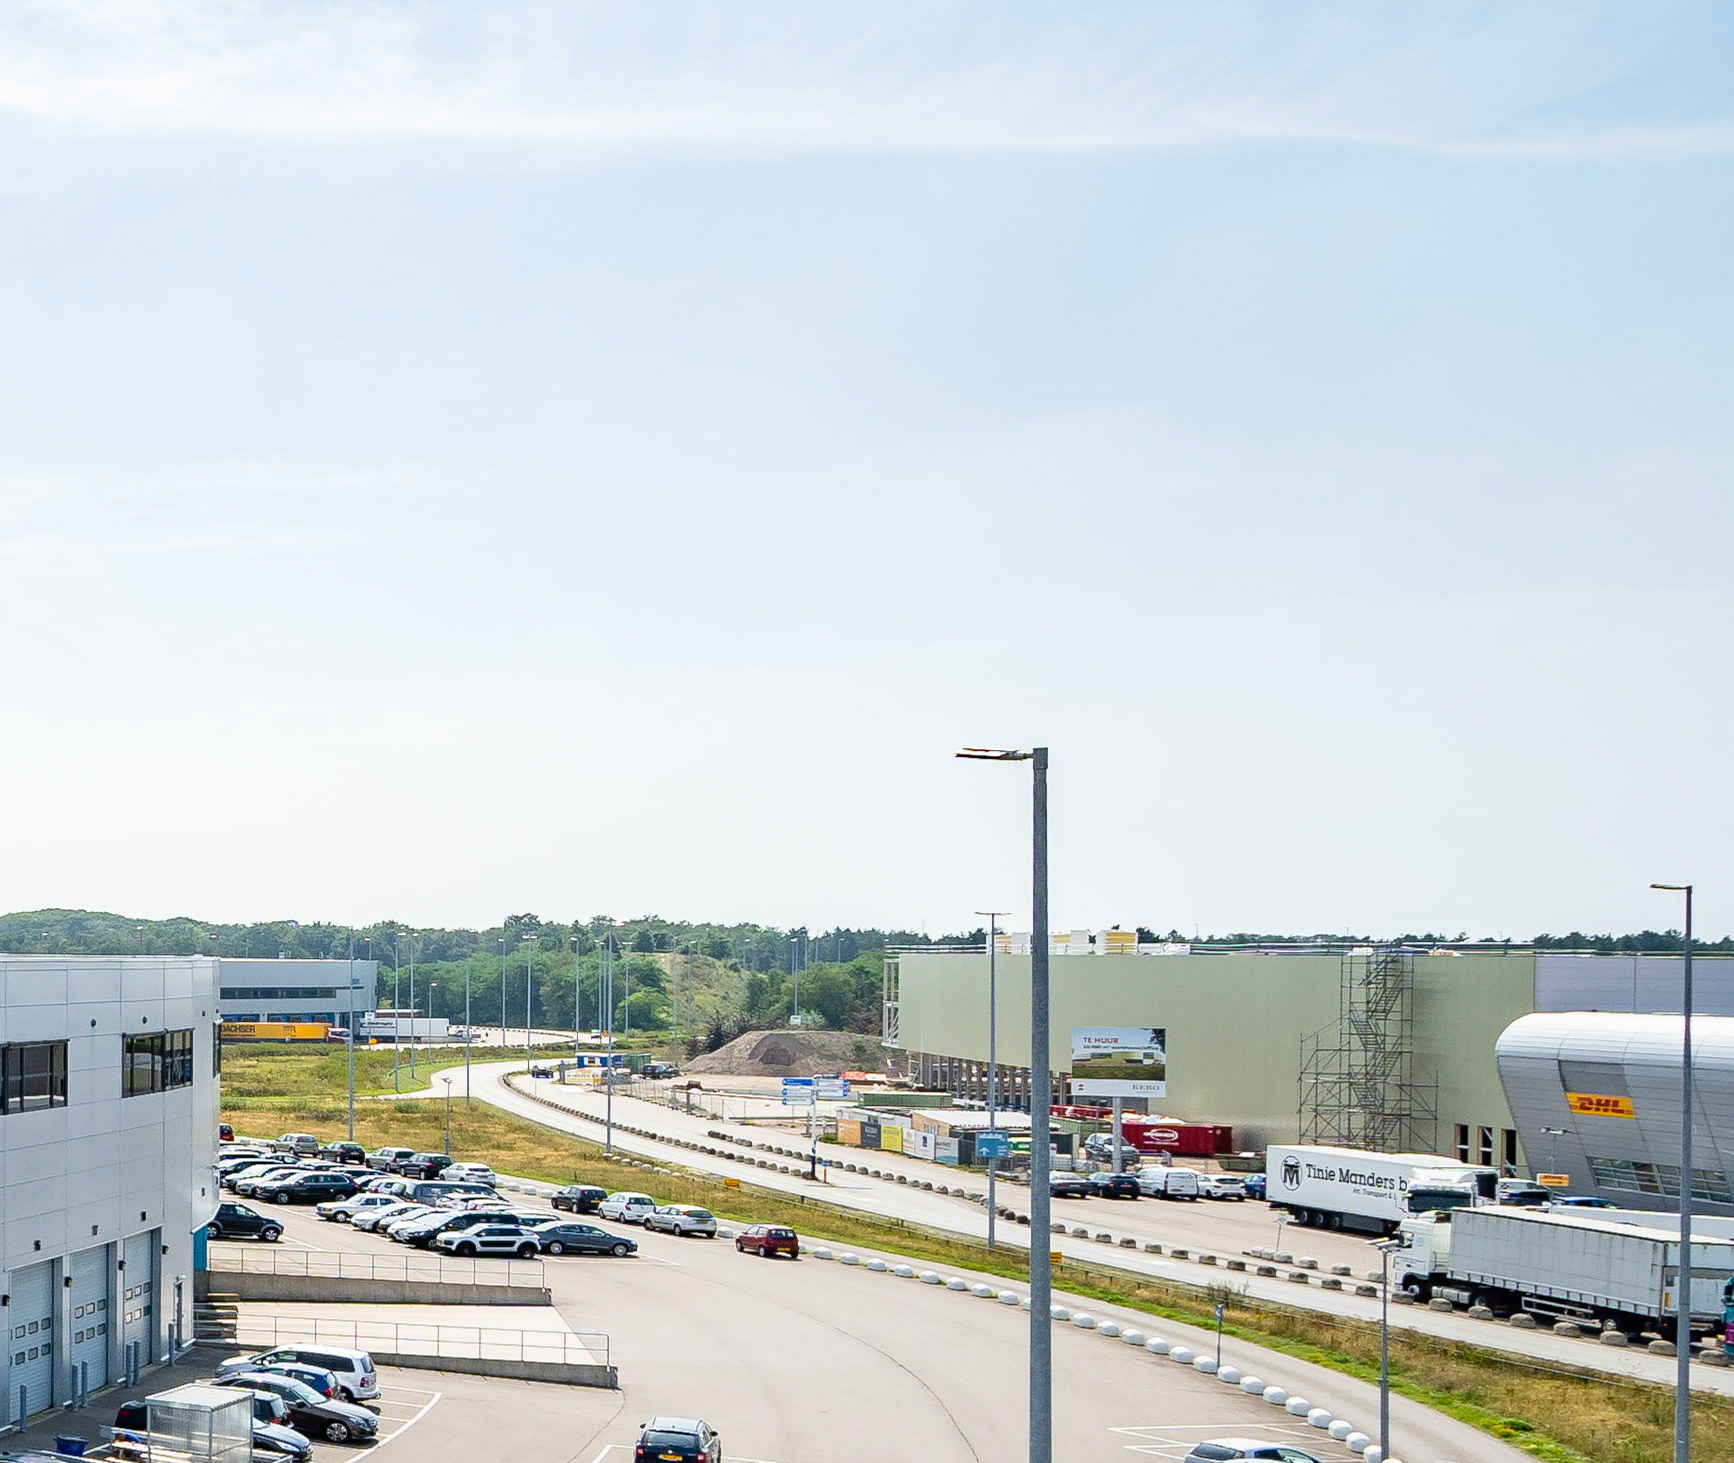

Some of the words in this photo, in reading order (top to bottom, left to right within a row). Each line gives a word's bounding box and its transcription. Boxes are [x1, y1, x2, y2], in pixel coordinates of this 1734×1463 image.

[1576, 1096, 1625, 1114] DHL
[1305, 1163, 1336, 1181] Tinie
[1338, 1168, 1395, 1190] Manders
